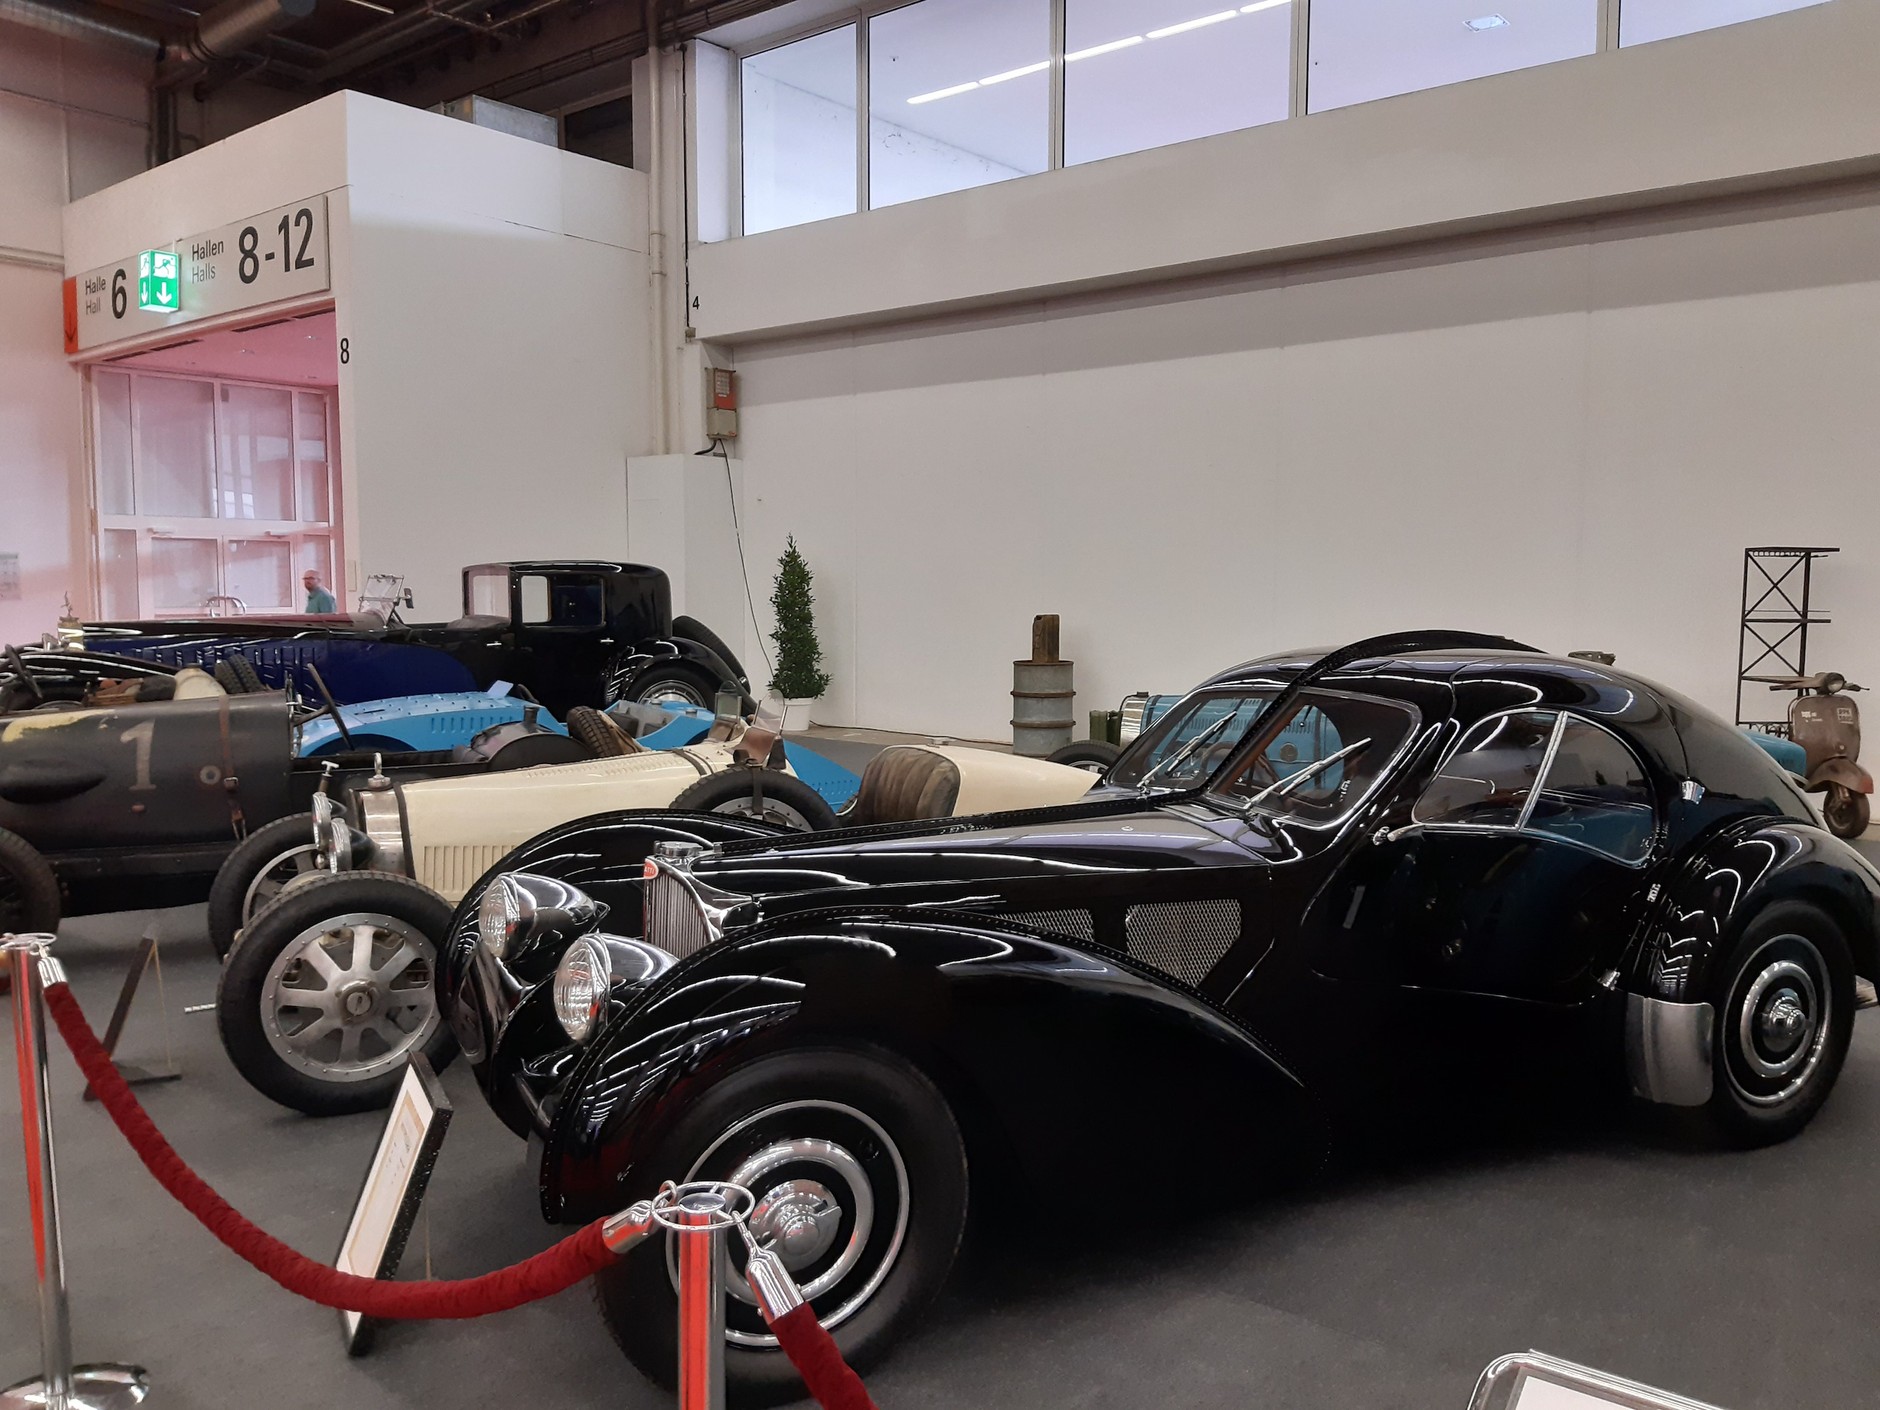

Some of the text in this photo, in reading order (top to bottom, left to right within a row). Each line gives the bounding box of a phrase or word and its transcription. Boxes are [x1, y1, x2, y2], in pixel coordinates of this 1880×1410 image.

[191, 240, 224, 262] Hallen
[238, 208, 315, 284] 8-12
[85, 275, 106, 295] Halle
[191, 264, 216, 284] Halls
[111, 268, 127, 319] 6
[692, 295, 700, 310] 4
[85, 299, 101, 315] Hall
[340, 337, 350, 364] 8
[120, 718, 157, 791] 1
